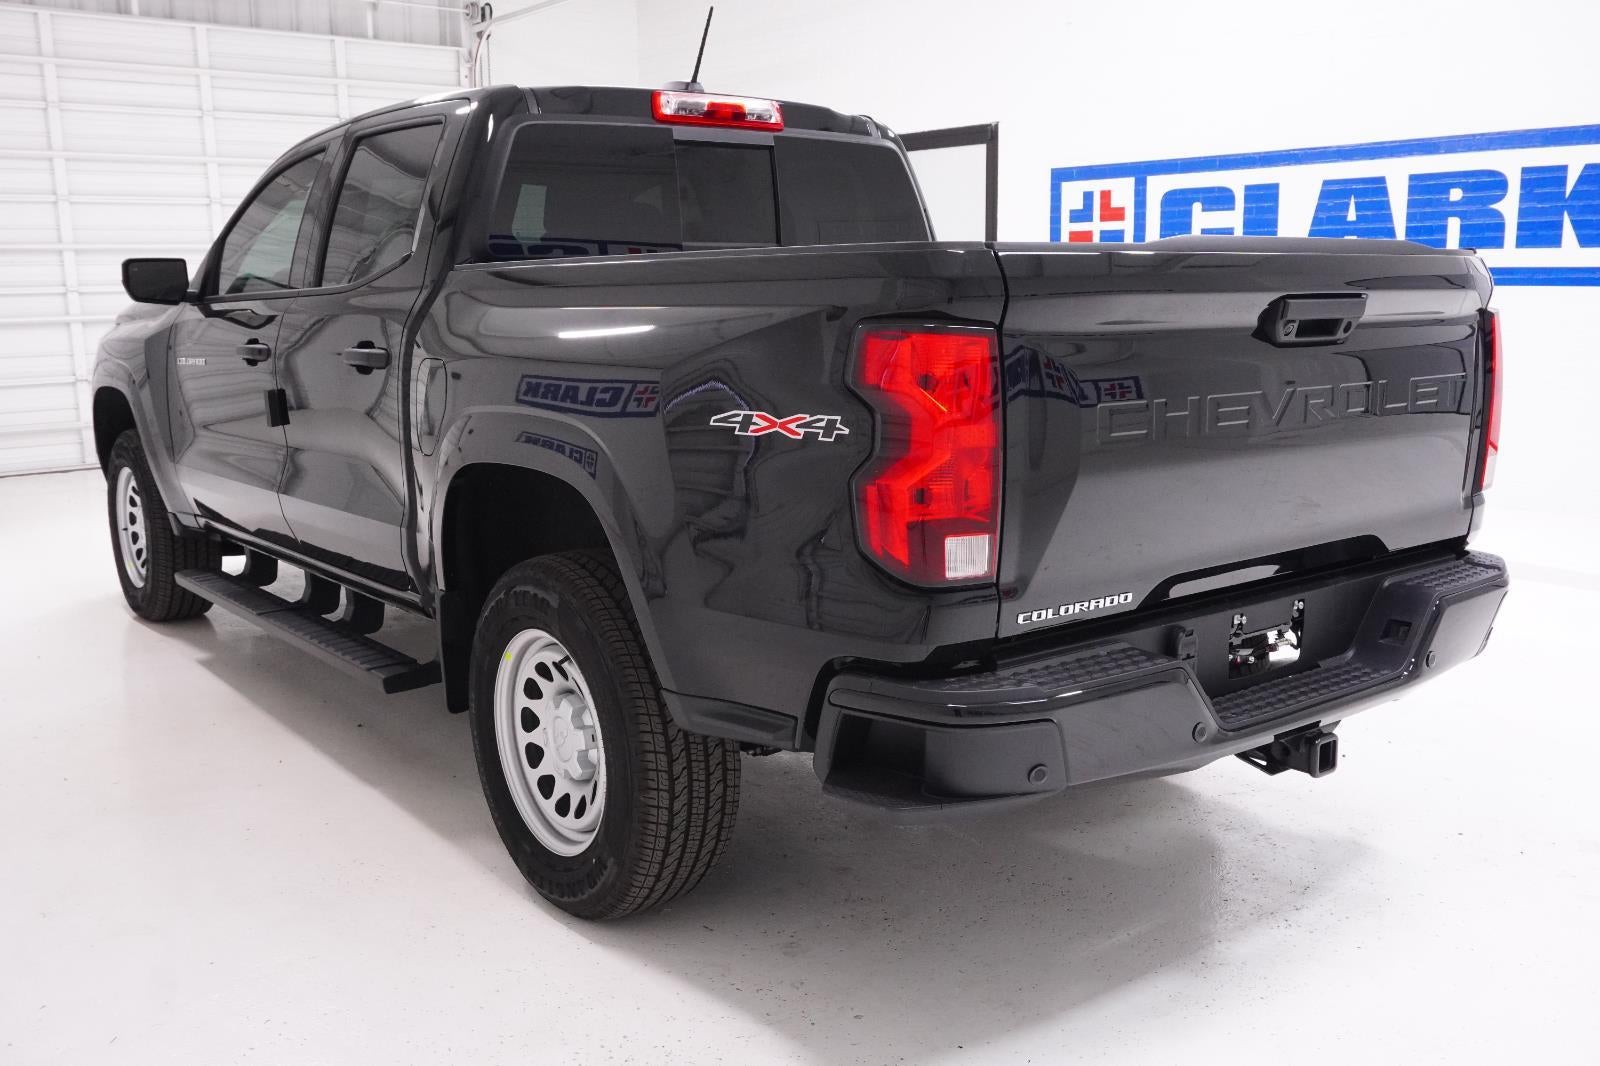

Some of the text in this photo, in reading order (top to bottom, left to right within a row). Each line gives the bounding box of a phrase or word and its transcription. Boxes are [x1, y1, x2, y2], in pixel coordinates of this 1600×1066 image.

[1160, 162, 1600, 249] CLARK
[1097, 372, 1467, 440] CHEVROLET
[1016, 592, 1133, 625] COLORADO
